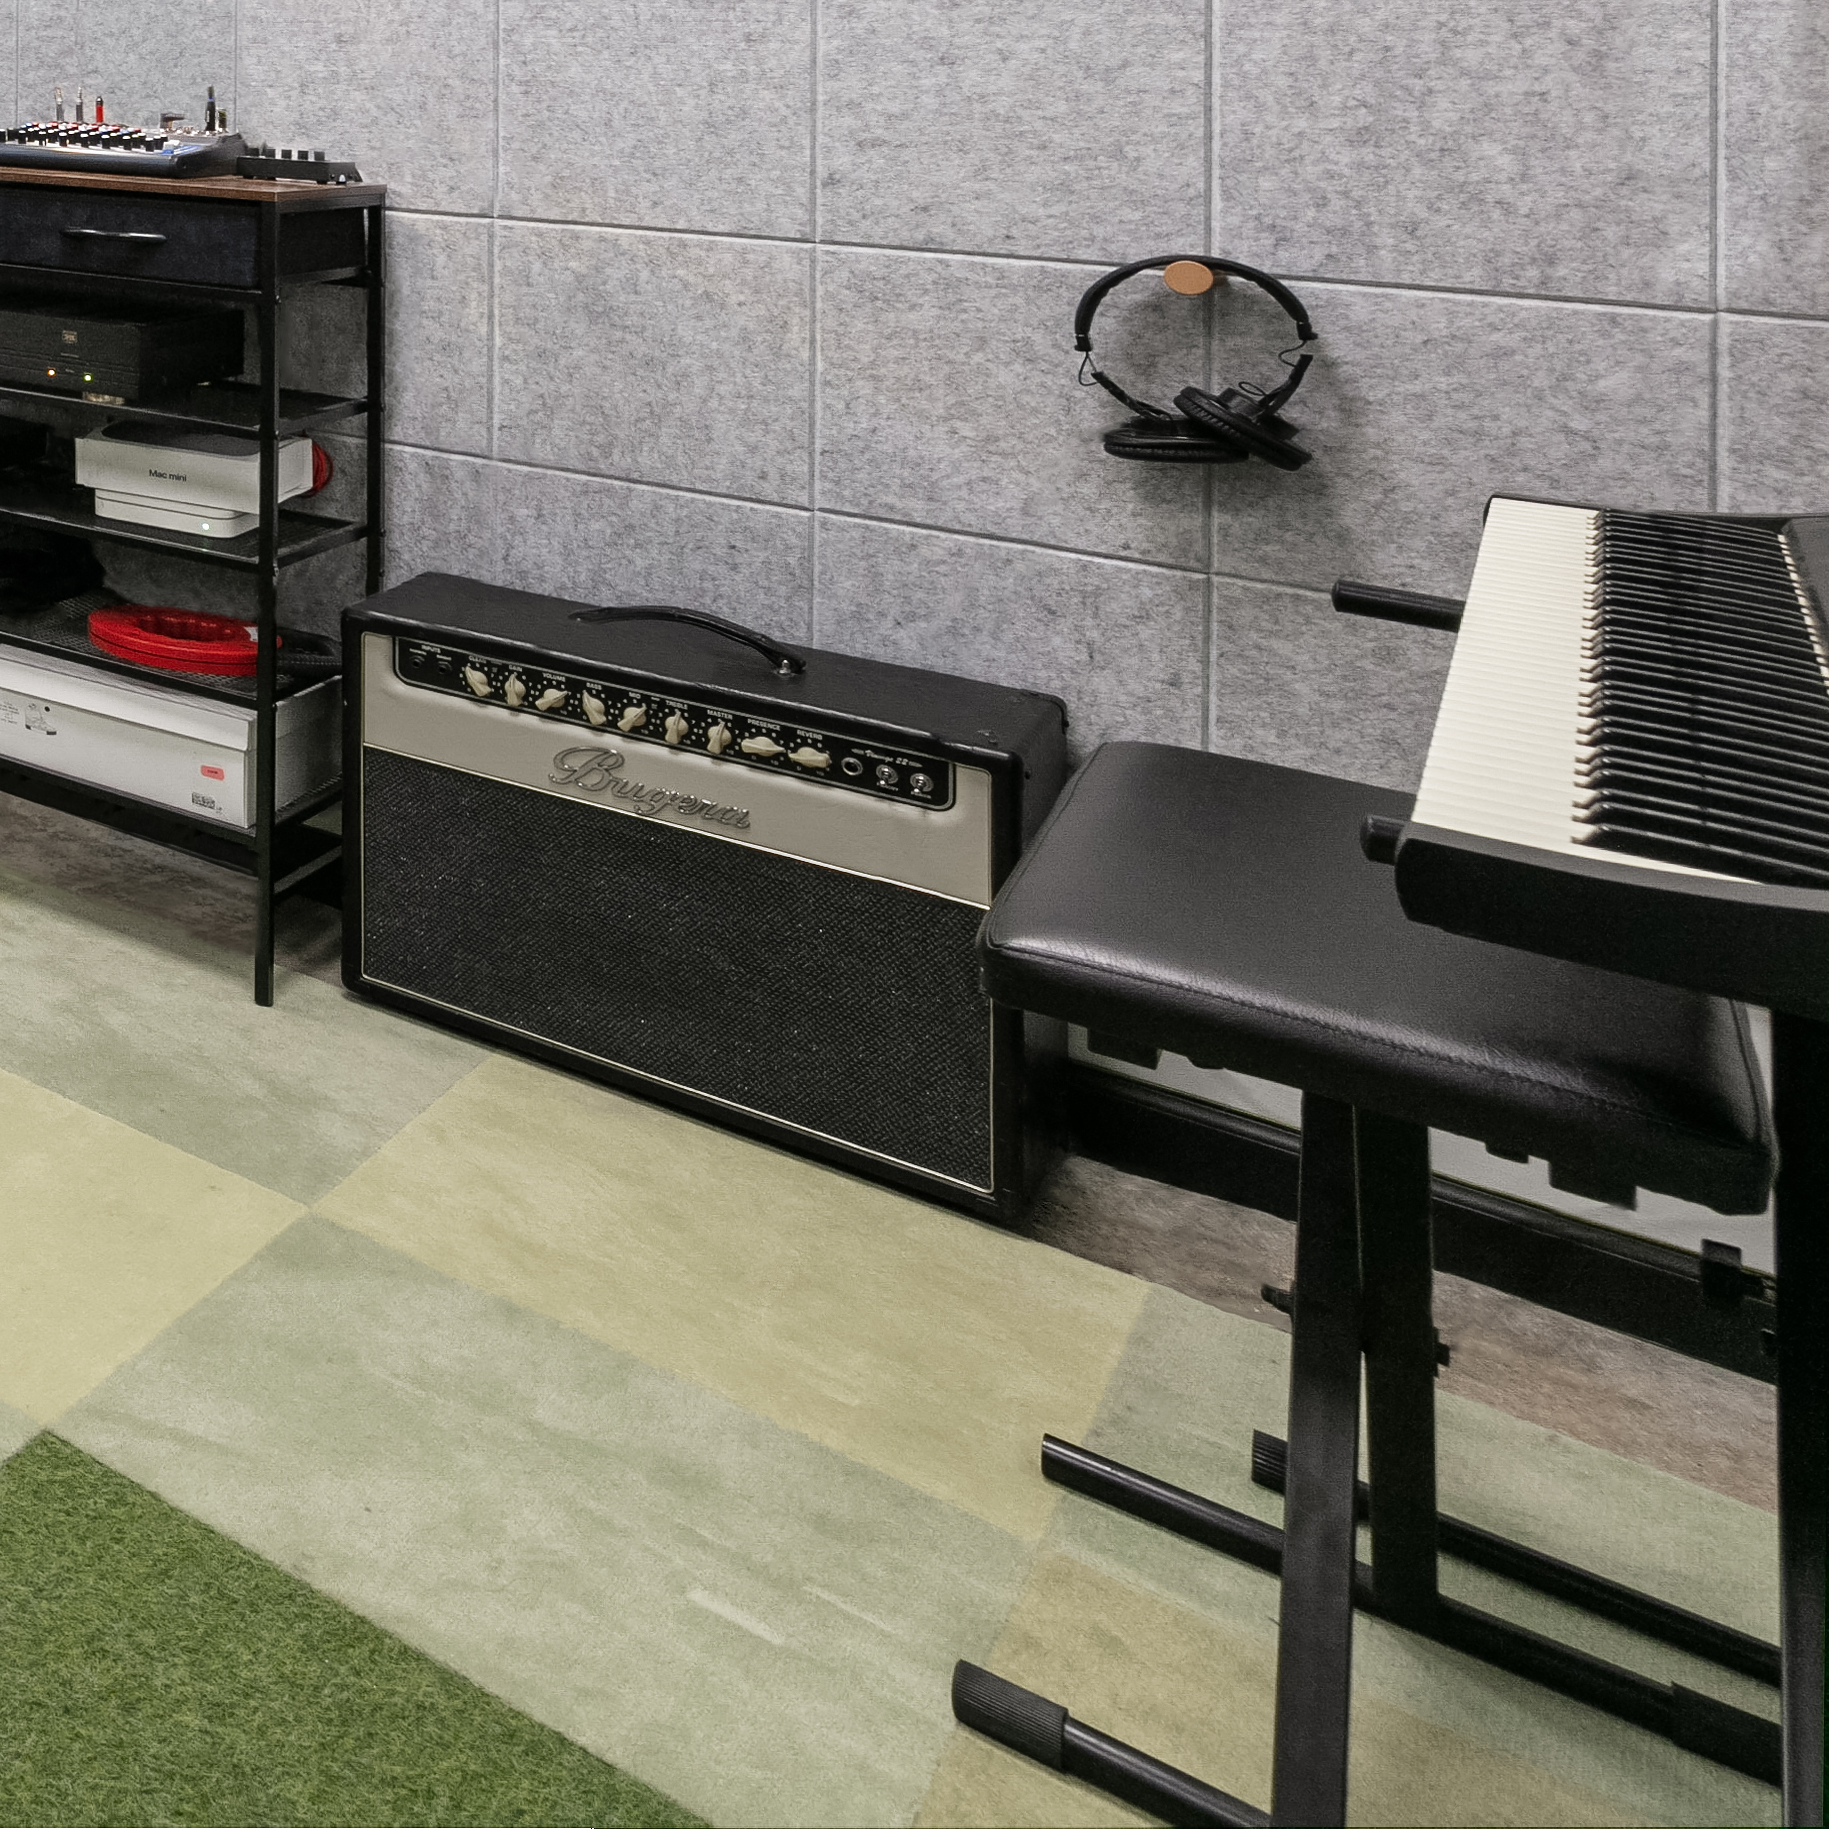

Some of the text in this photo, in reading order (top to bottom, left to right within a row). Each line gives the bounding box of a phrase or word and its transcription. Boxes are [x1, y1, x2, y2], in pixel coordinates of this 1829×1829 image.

[149, 469, 187, 482] Mac mini
[421, 645, 441, 653] INPUTS
[469, 655, 487, 663] CLEAN
[542, 672, 566, 682] VOLUME
[586, 682, 602, 690] BASS
[665, 700, 688, 710] TREBLE
[707, 710, 733, 720] MASTER
[747, 719, 781, 731] PRESENCE
[797, 730, 823, 740] REVERB
[548, 746, 751, 829] Bugera
